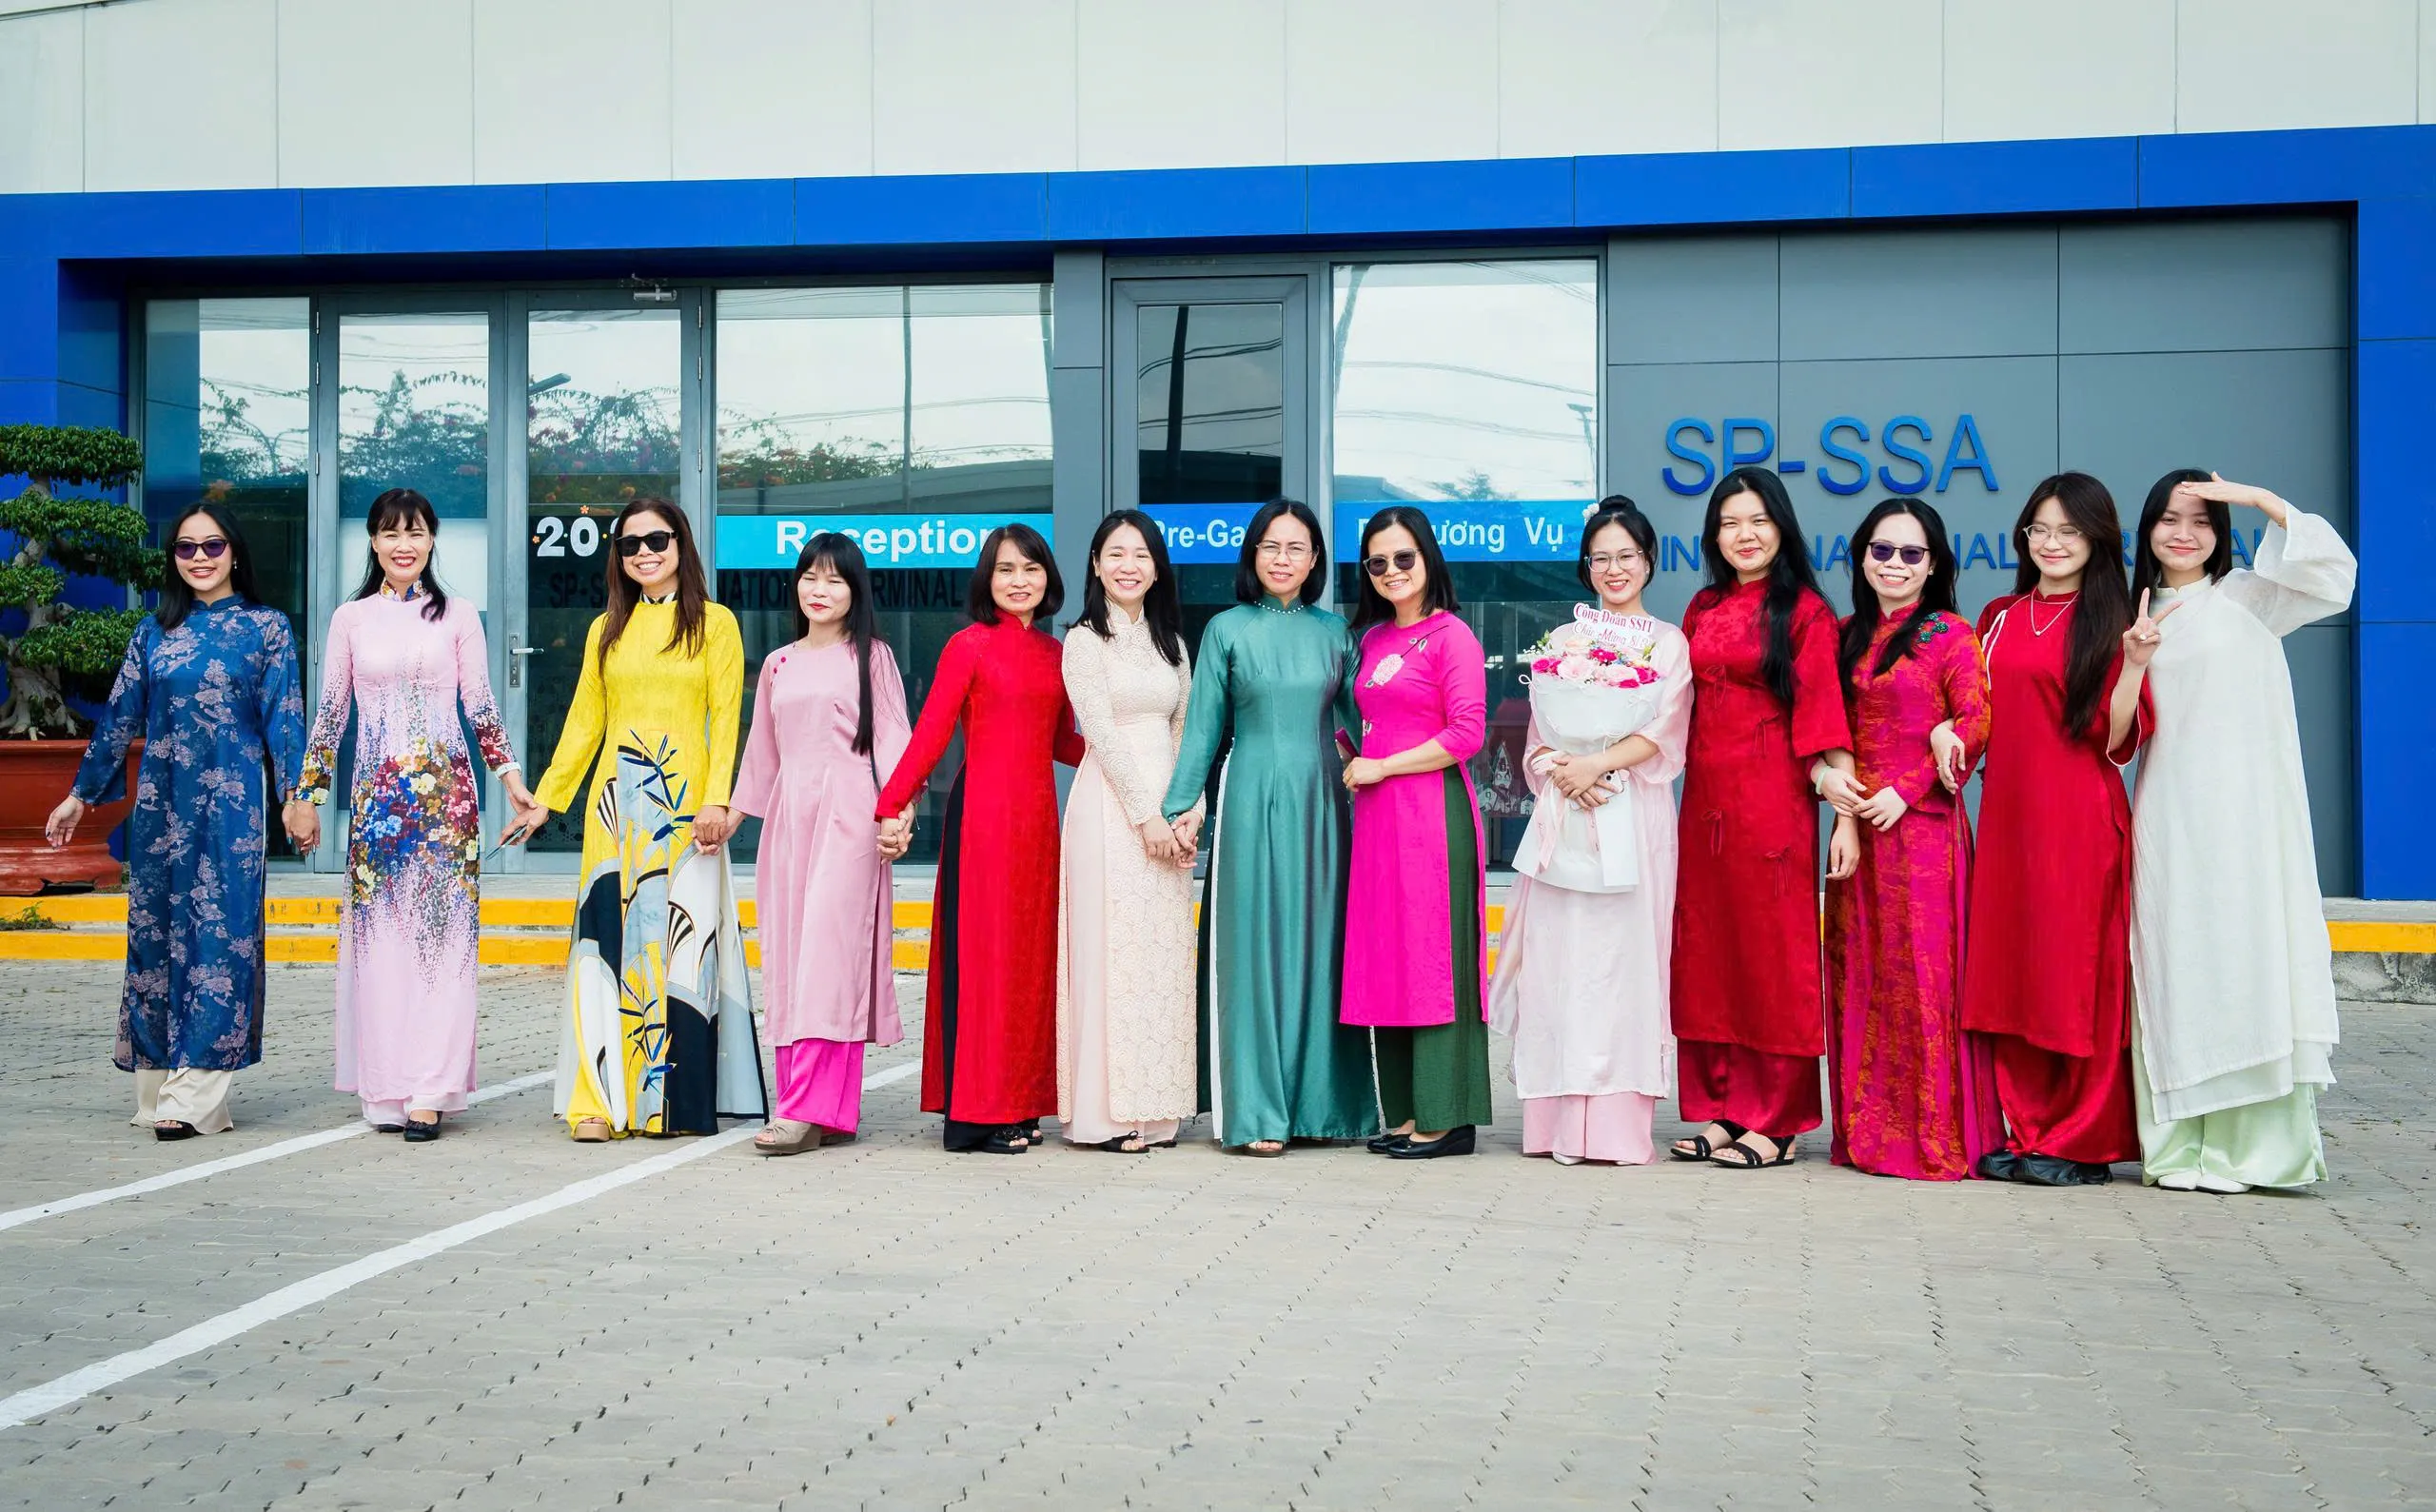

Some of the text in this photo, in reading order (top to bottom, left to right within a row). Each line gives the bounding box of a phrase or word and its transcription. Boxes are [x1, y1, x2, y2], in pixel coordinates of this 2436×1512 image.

[1662, 414, 1999, 496] SP-SSA
[537, 517, 619, 557] 20
[776, 520, 995, 562] Reptio
[1432, 517, 1563, 553] ương Vụ
[549, 570, 964, 608] SP-S RMINAL
[1575, 604, 1599, 624] Công
[1628, 617, 1655, 633] SSIT
